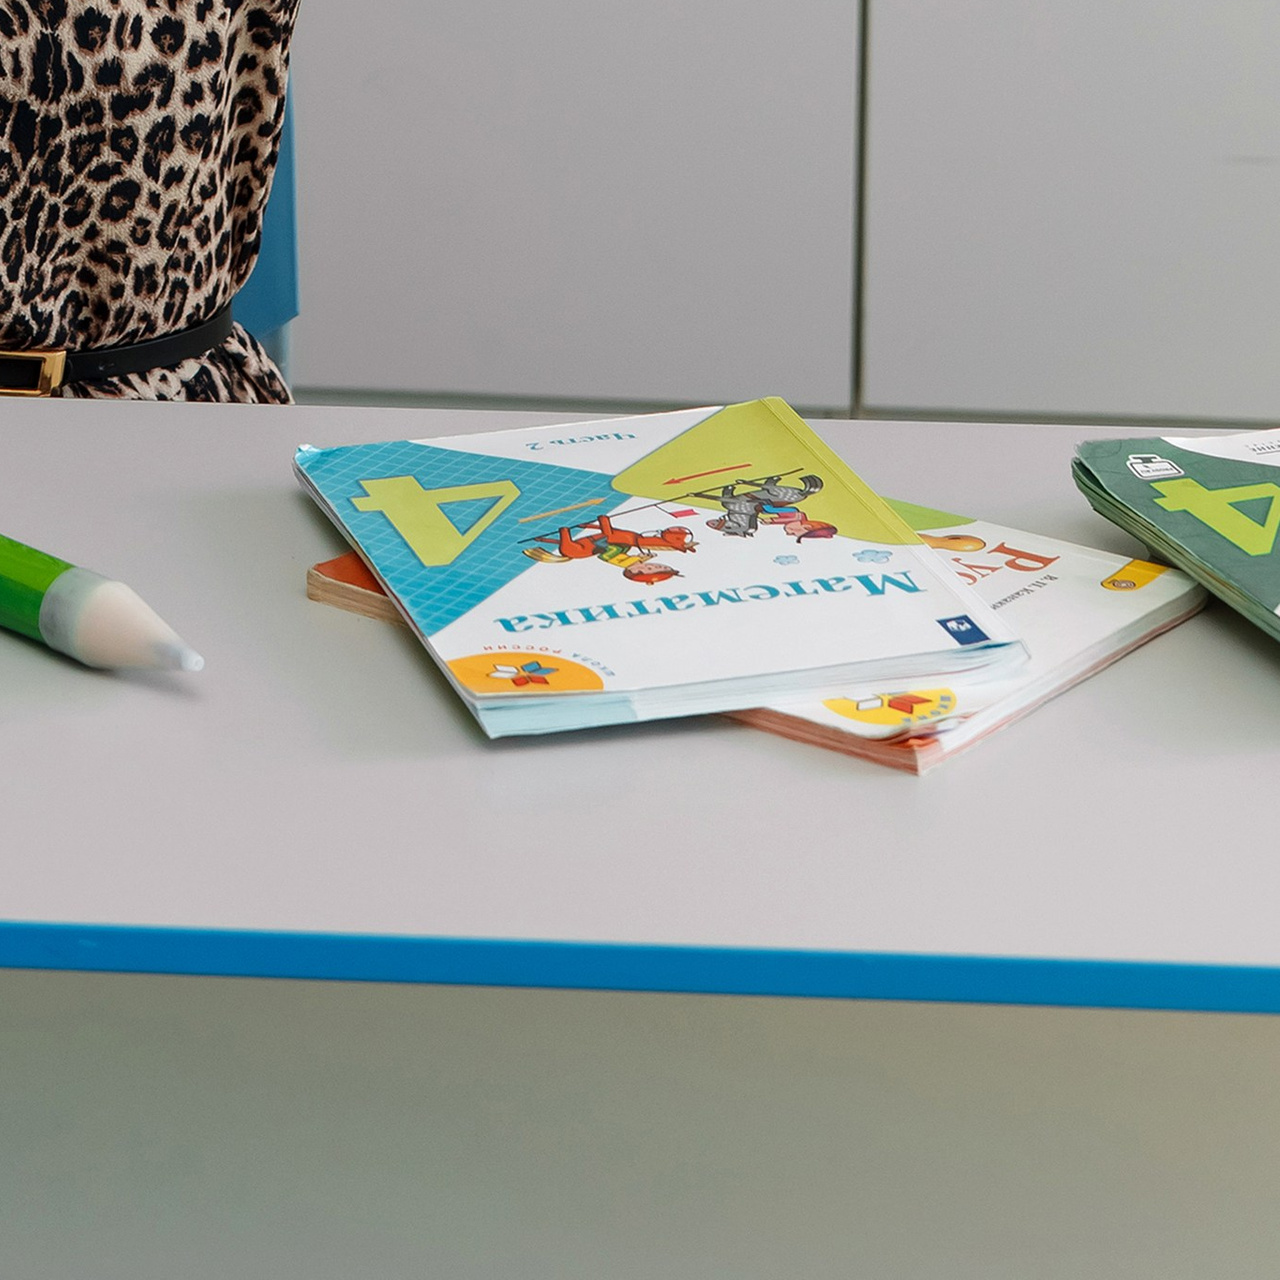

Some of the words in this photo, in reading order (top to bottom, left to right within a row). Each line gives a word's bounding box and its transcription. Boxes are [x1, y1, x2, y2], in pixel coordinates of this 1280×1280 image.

[351, 476, 521, 567] 4
[1150, 478, 1280, 557] 4
[491, 569, 929, 637] Математика
